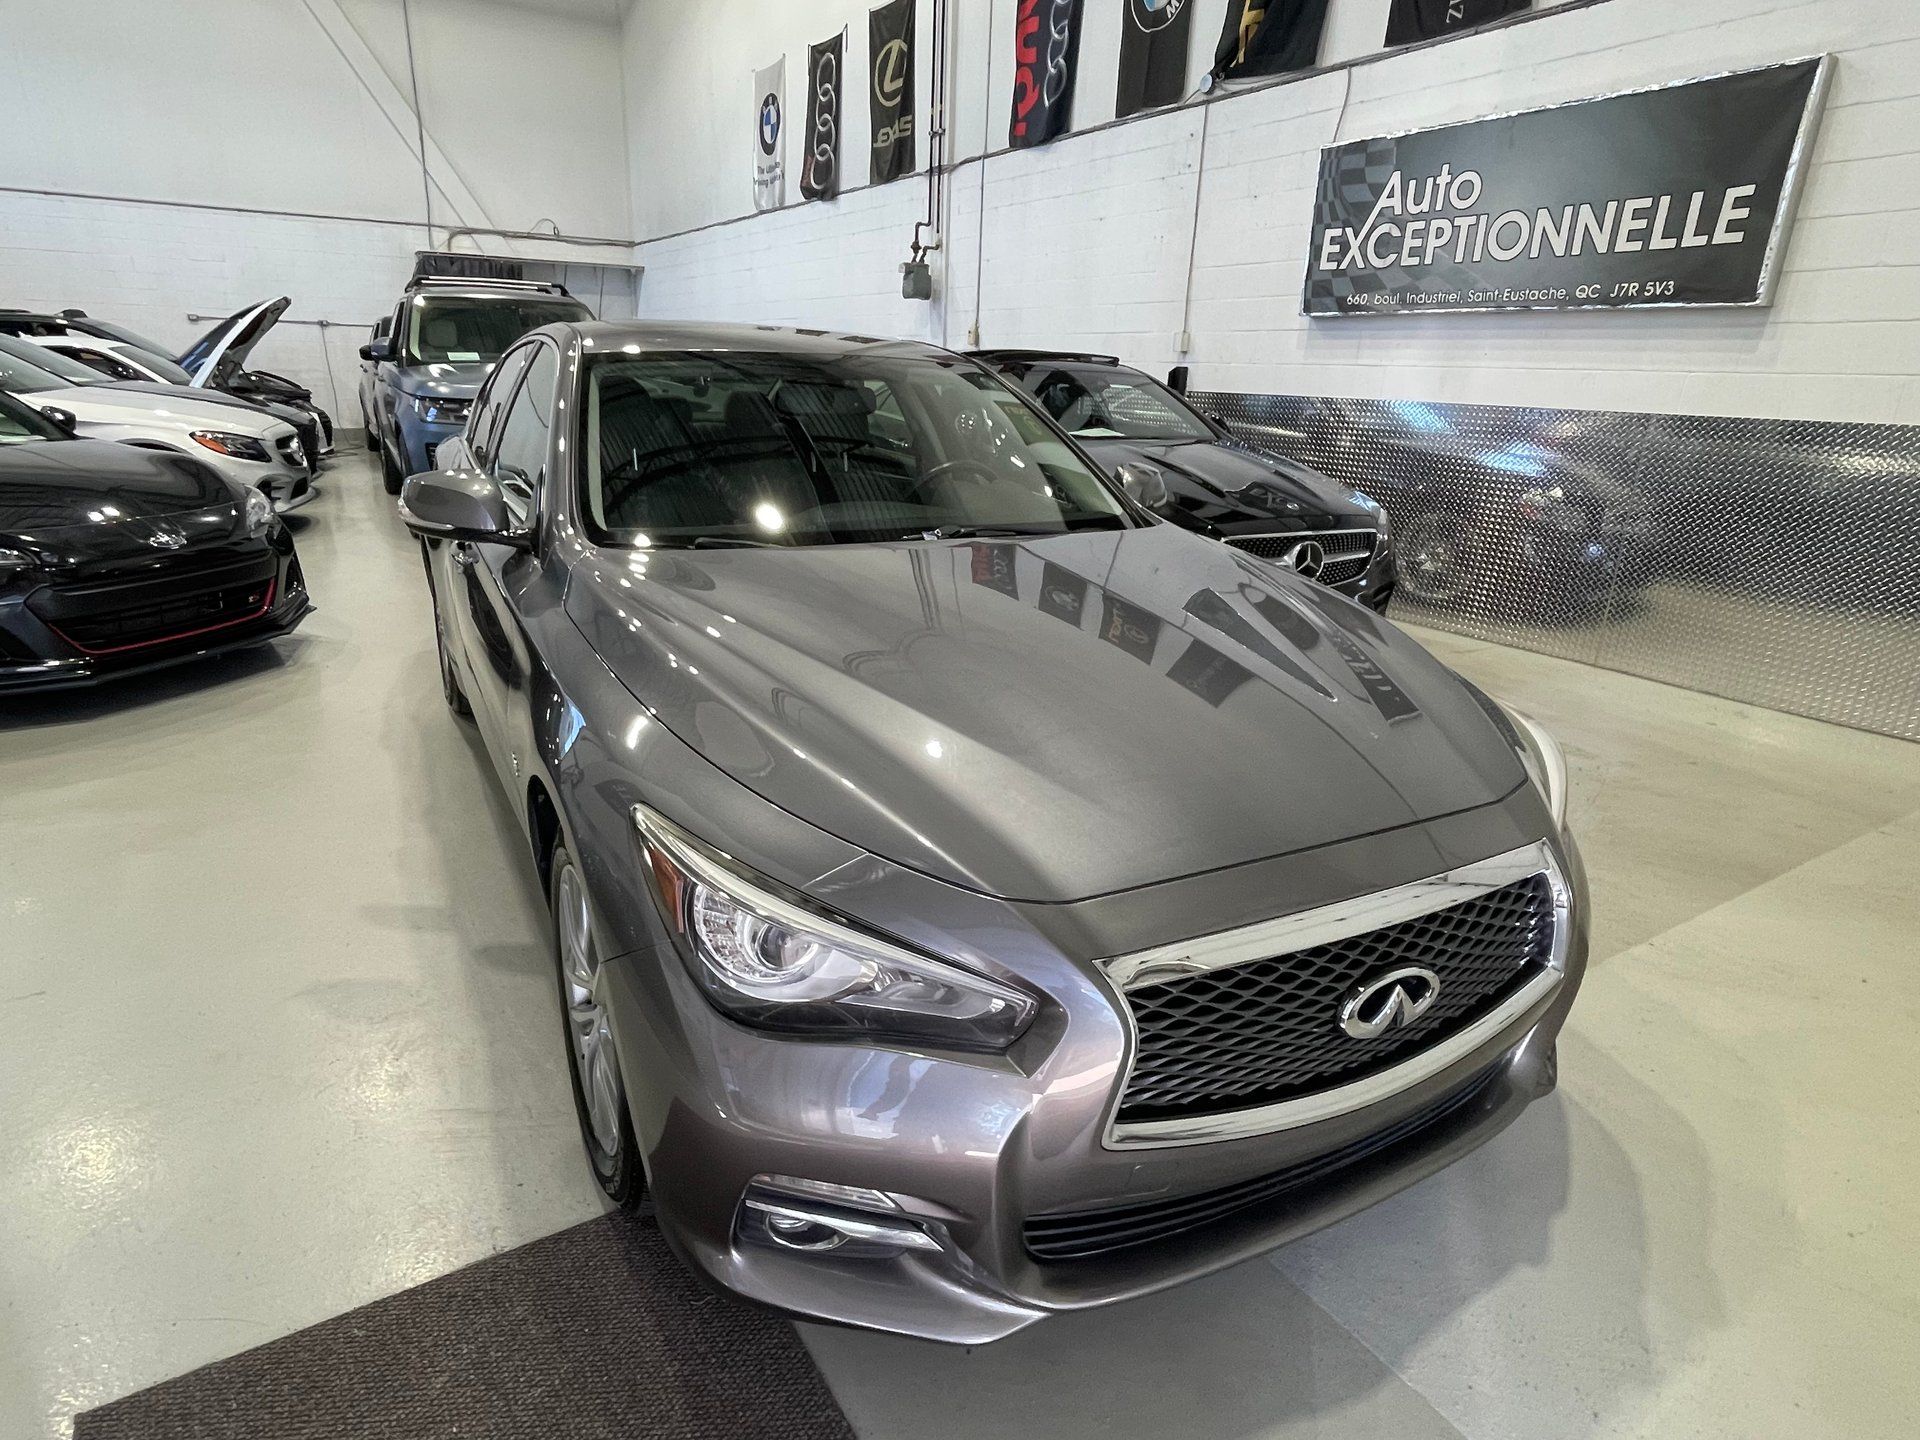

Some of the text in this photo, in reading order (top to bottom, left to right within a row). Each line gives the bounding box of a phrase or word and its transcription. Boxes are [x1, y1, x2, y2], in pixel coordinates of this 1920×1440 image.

[1318, 183, 1757, 271] EXCEPTIONNELLE
[1360, 163, 1482, 234] Auto
[1406, 290, 1463, 304] Industriel,
[1467, 286, 1570, 303] Saint-Eustache,
[1575, 284, 1601, 299] QC
[1610, 282, 1640, 298] J7R
[1644, 280, 1675, 297] 5V3
